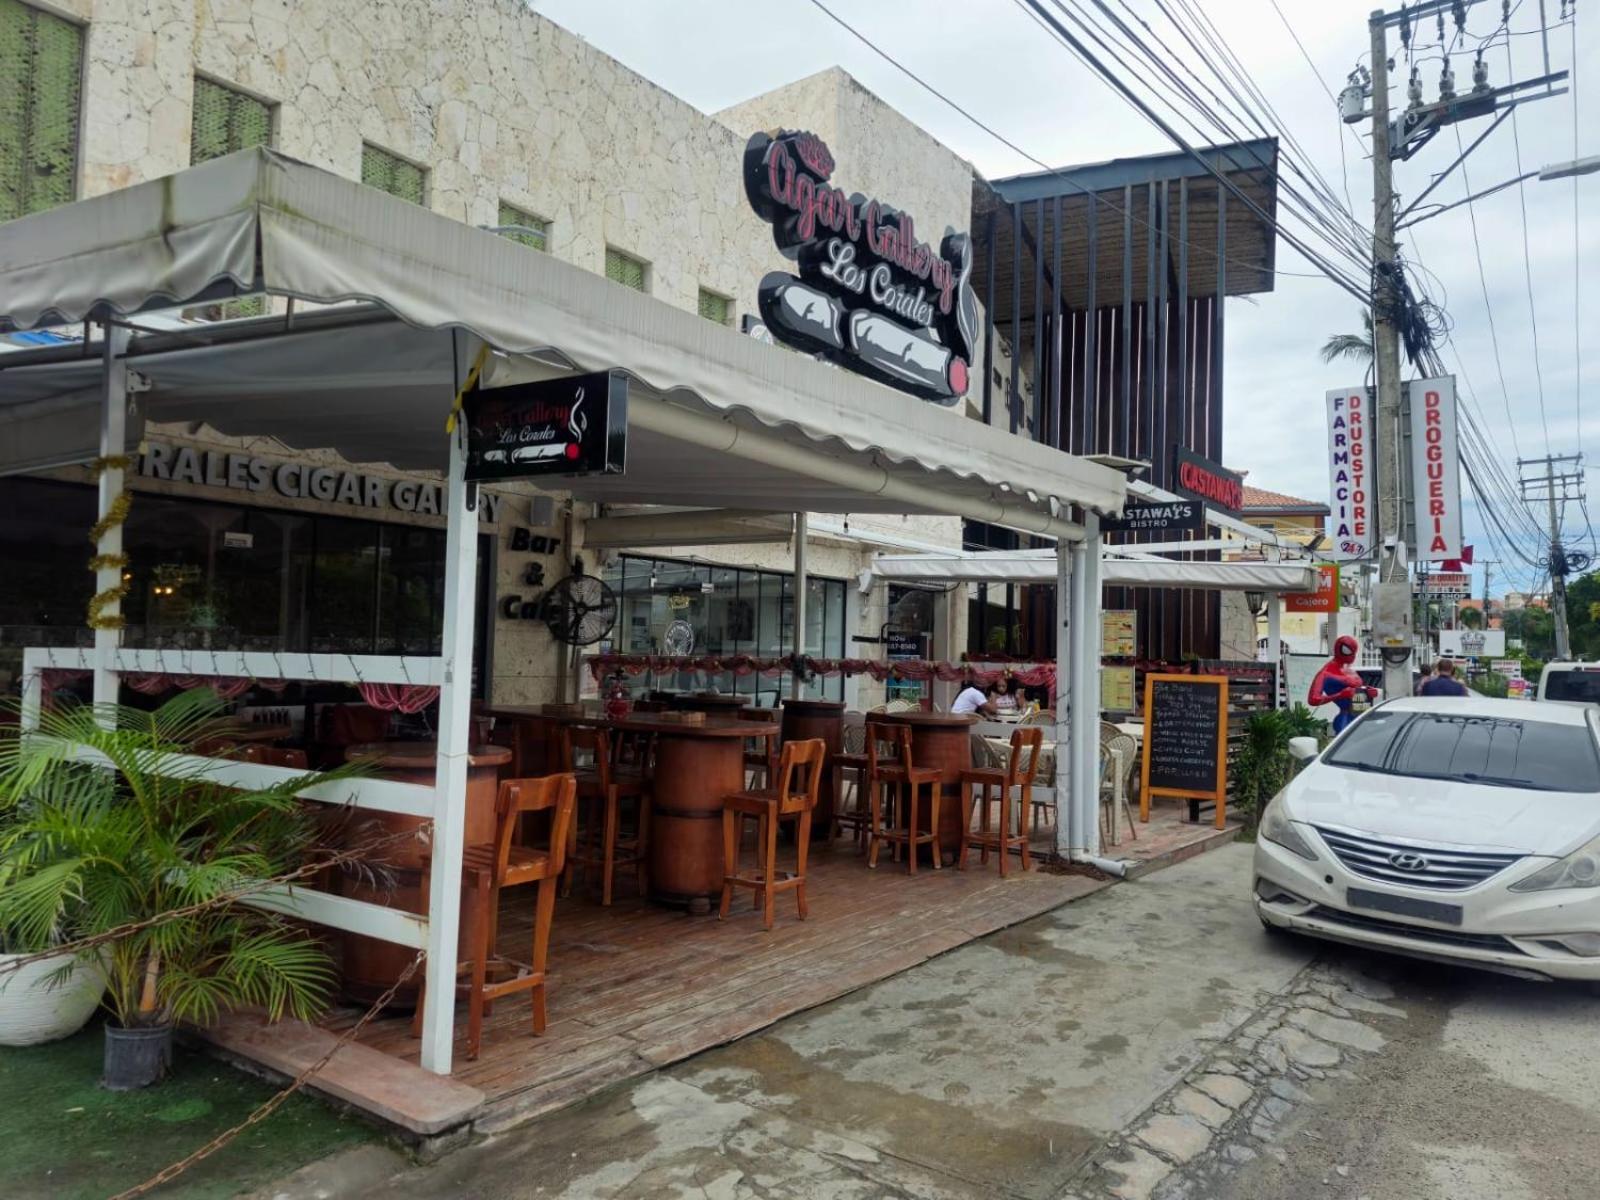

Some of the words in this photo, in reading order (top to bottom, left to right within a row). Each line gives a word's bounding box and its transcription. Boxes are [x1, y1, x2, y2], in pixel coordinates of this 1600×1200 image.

[820, 237, 866, 295] Los
[870, 262, 934, 325] Corales
[866, 198, 953, 314] Gallery
[519, 422, 556, 442] Corales
[1333, 397, 1350, 537] FARMACIA
[1349, 395, 1366, 536] DRUGSTORE
[1424, 390, 1447, 553] DROGUERIA
[274, 461, 389, 508] CIGAR
[1130, 519, 1168, 528] BISTRO
[511, 527, 561, 555] Bar
